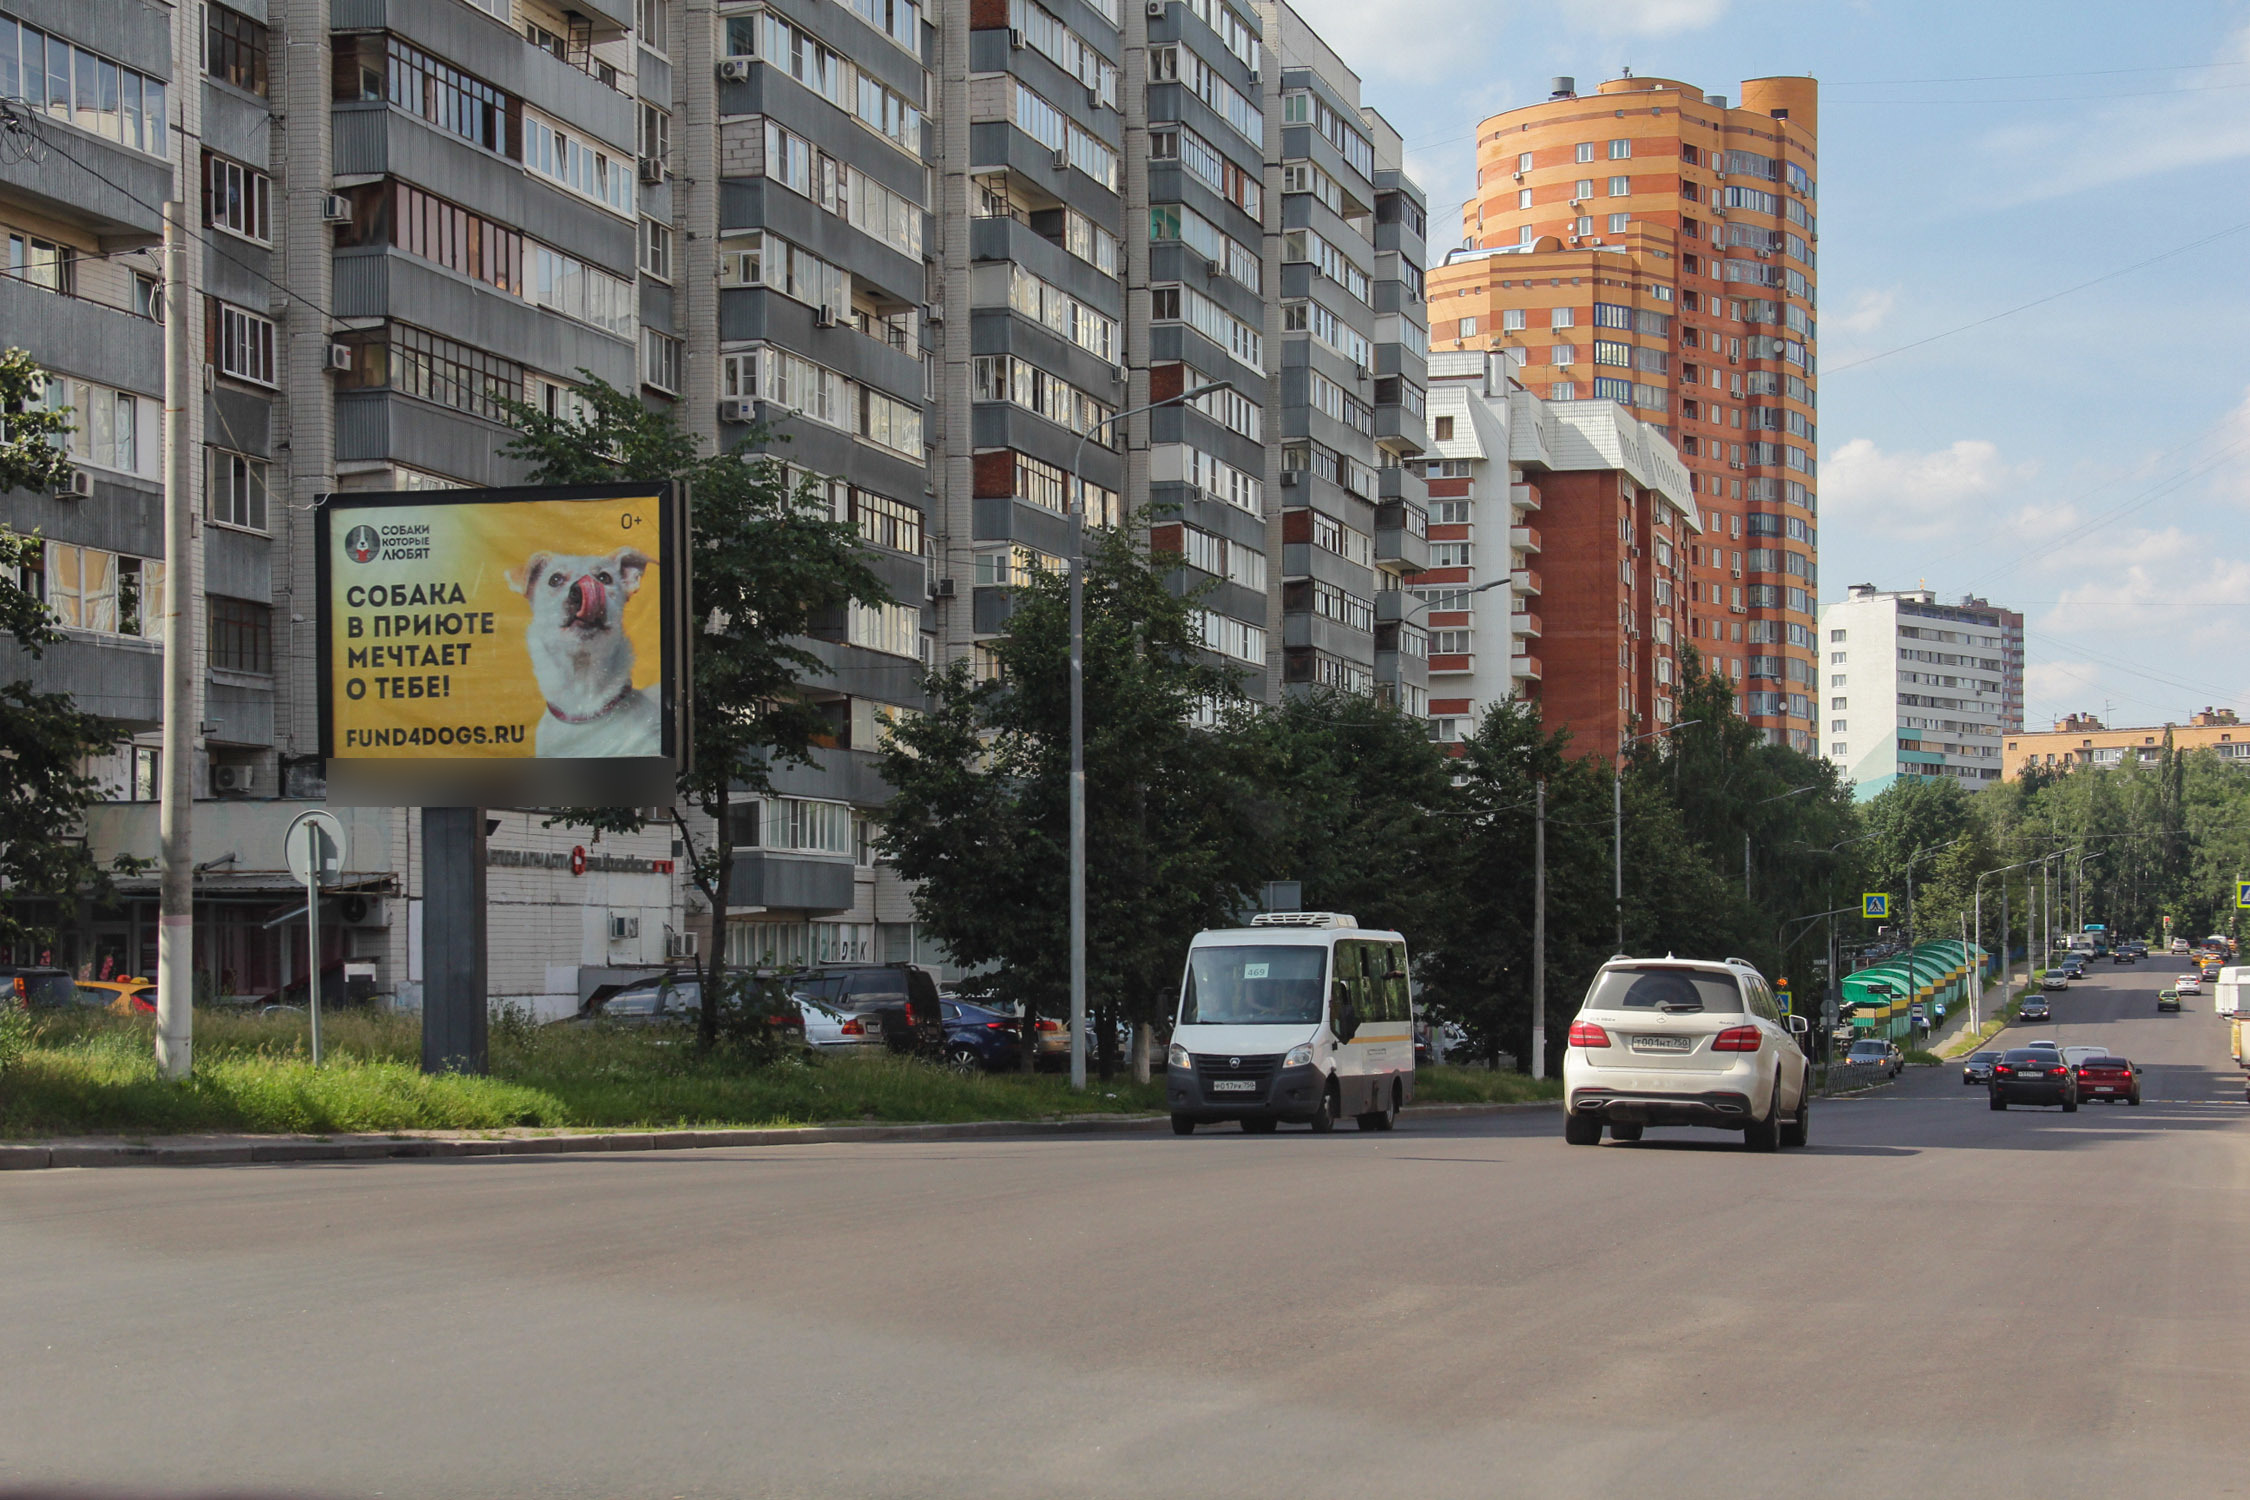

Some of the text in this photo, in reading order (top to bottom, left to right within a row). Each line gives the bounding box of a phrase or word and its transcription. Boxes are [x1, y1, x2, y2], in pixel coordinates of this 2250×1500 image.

[381, 524, 430, 536] СОБАКИ
[621, 513, 642, 529] 0+
[382, 537, 430, 547] КОТОРЫЕ
[382, 547, 431, 561] ЛЮБЯТ
[346, 583, 466, 608] СОБАКА
[348, 612, 494, 638] В ПРИЮТЕ
[348, 643, 472, 668] МЕЧТАЕТ
[346, 675, 450, 700] О ТЕБЕ!
[346, 725, 525, 748] FUND4DOGS.RU
[1247, 968, 1265, 977] 469
